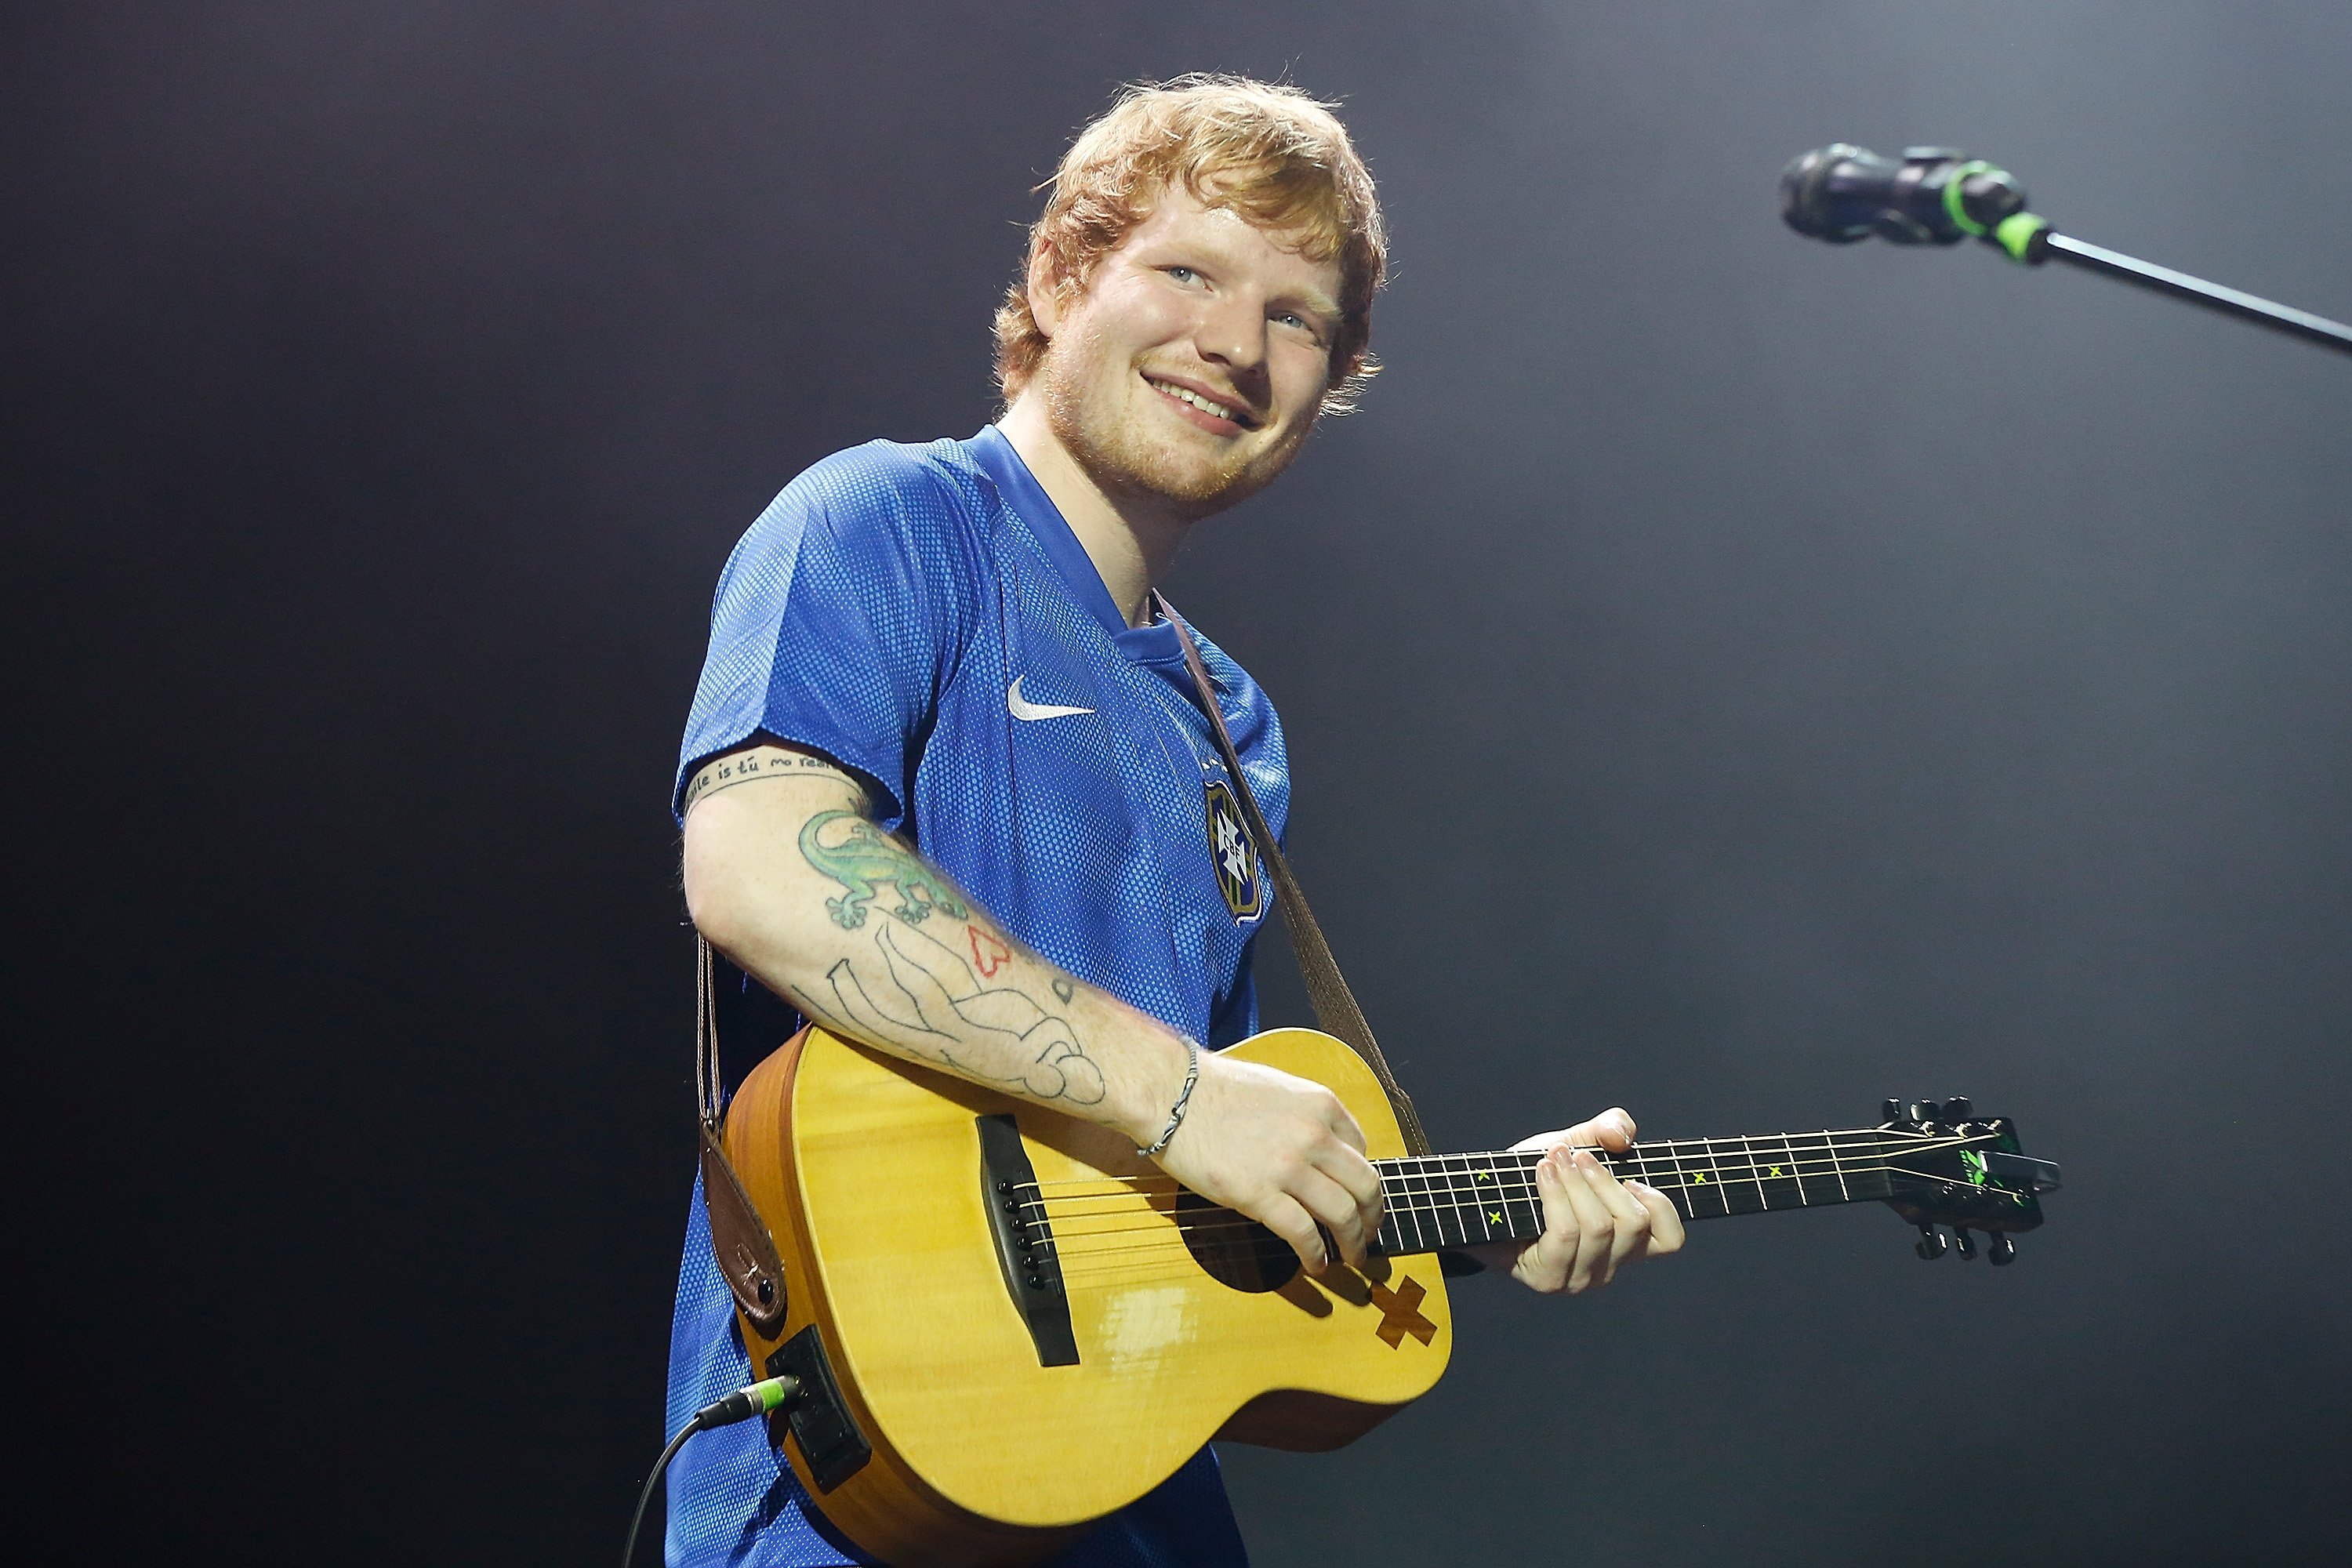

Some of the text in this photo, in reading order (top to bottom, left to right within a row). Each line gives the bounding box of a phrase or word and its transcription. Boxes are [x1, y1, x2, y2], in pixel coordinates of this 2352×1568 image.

[718, 763, 731, 779] is
[771, 758, 792, 767] mo
[1223, 833, 1240, 860] CBF
